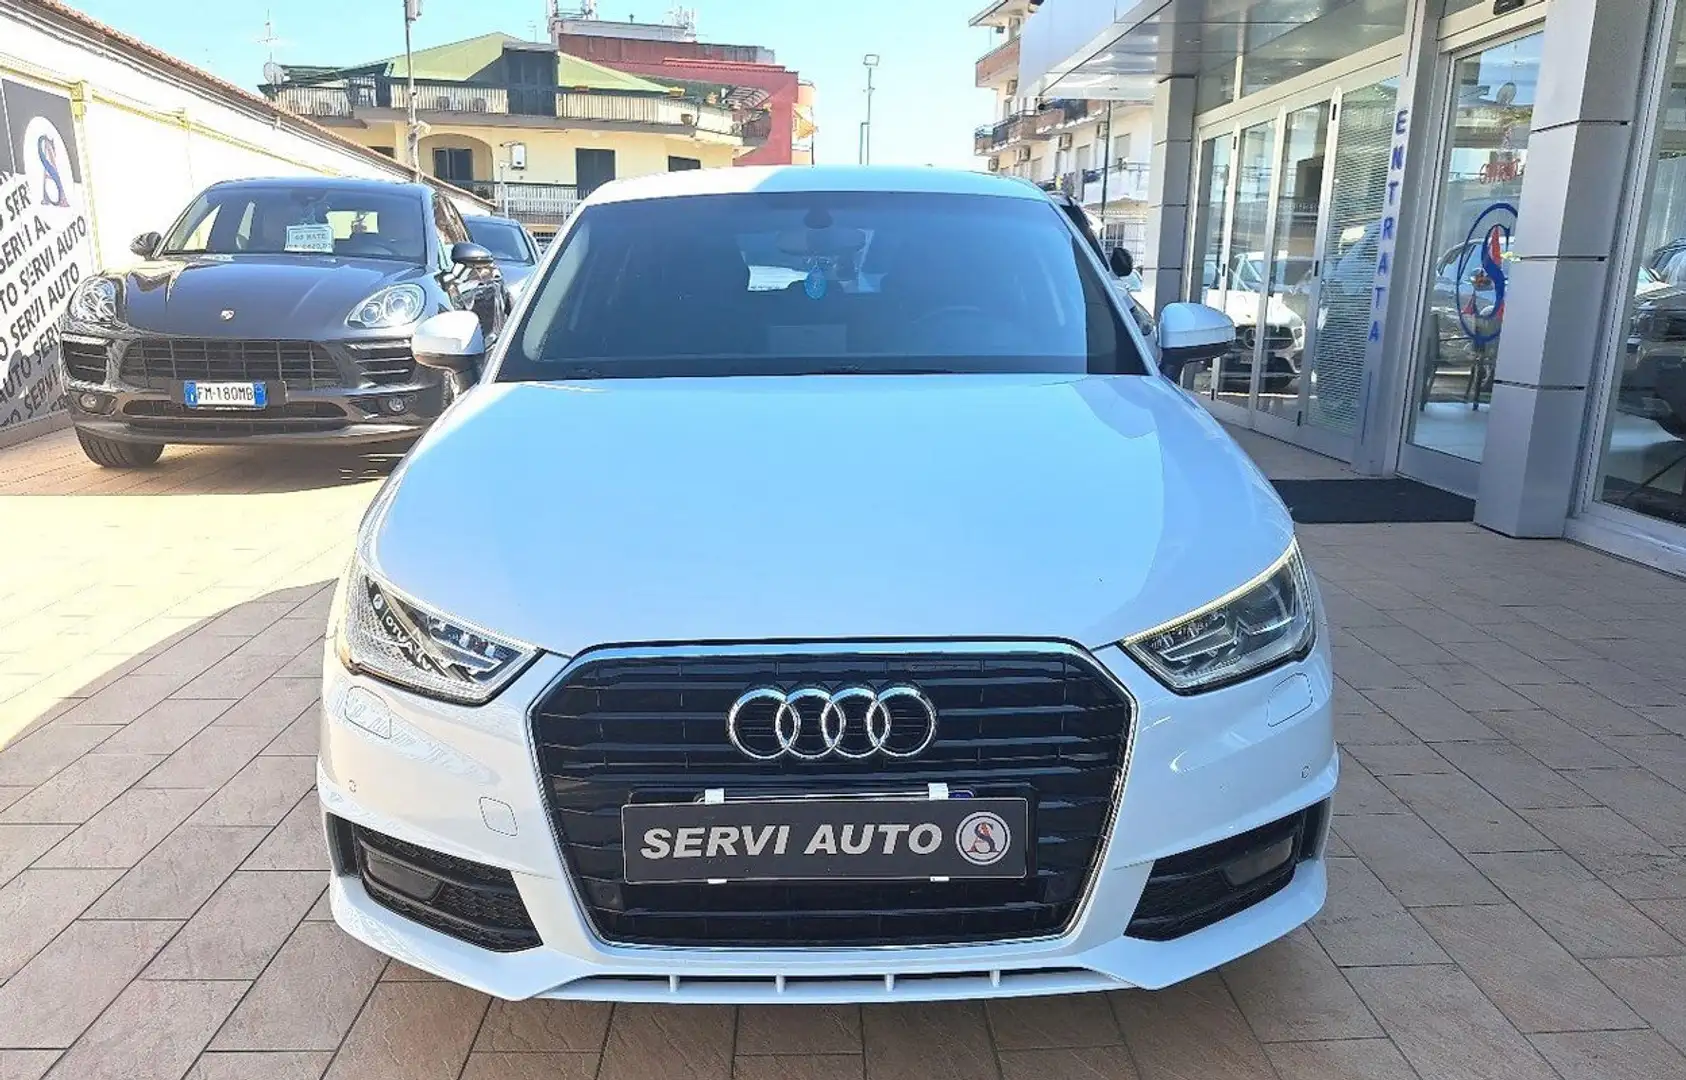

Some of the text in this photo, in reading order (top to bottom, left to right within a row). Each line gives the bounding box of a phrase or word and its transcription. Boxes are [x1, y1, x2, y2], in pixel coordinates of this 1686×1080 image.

[19, 245, 56, 295] SERVI
[57, 215, 87, 261] AUTO
[1368, 109, 1408, 343] ENTRATA
[10, 262, 79, 348] SERVI AUTO
[640, 824, 790, 860] SERVI
[803, 823, 943, 855] AUTO
